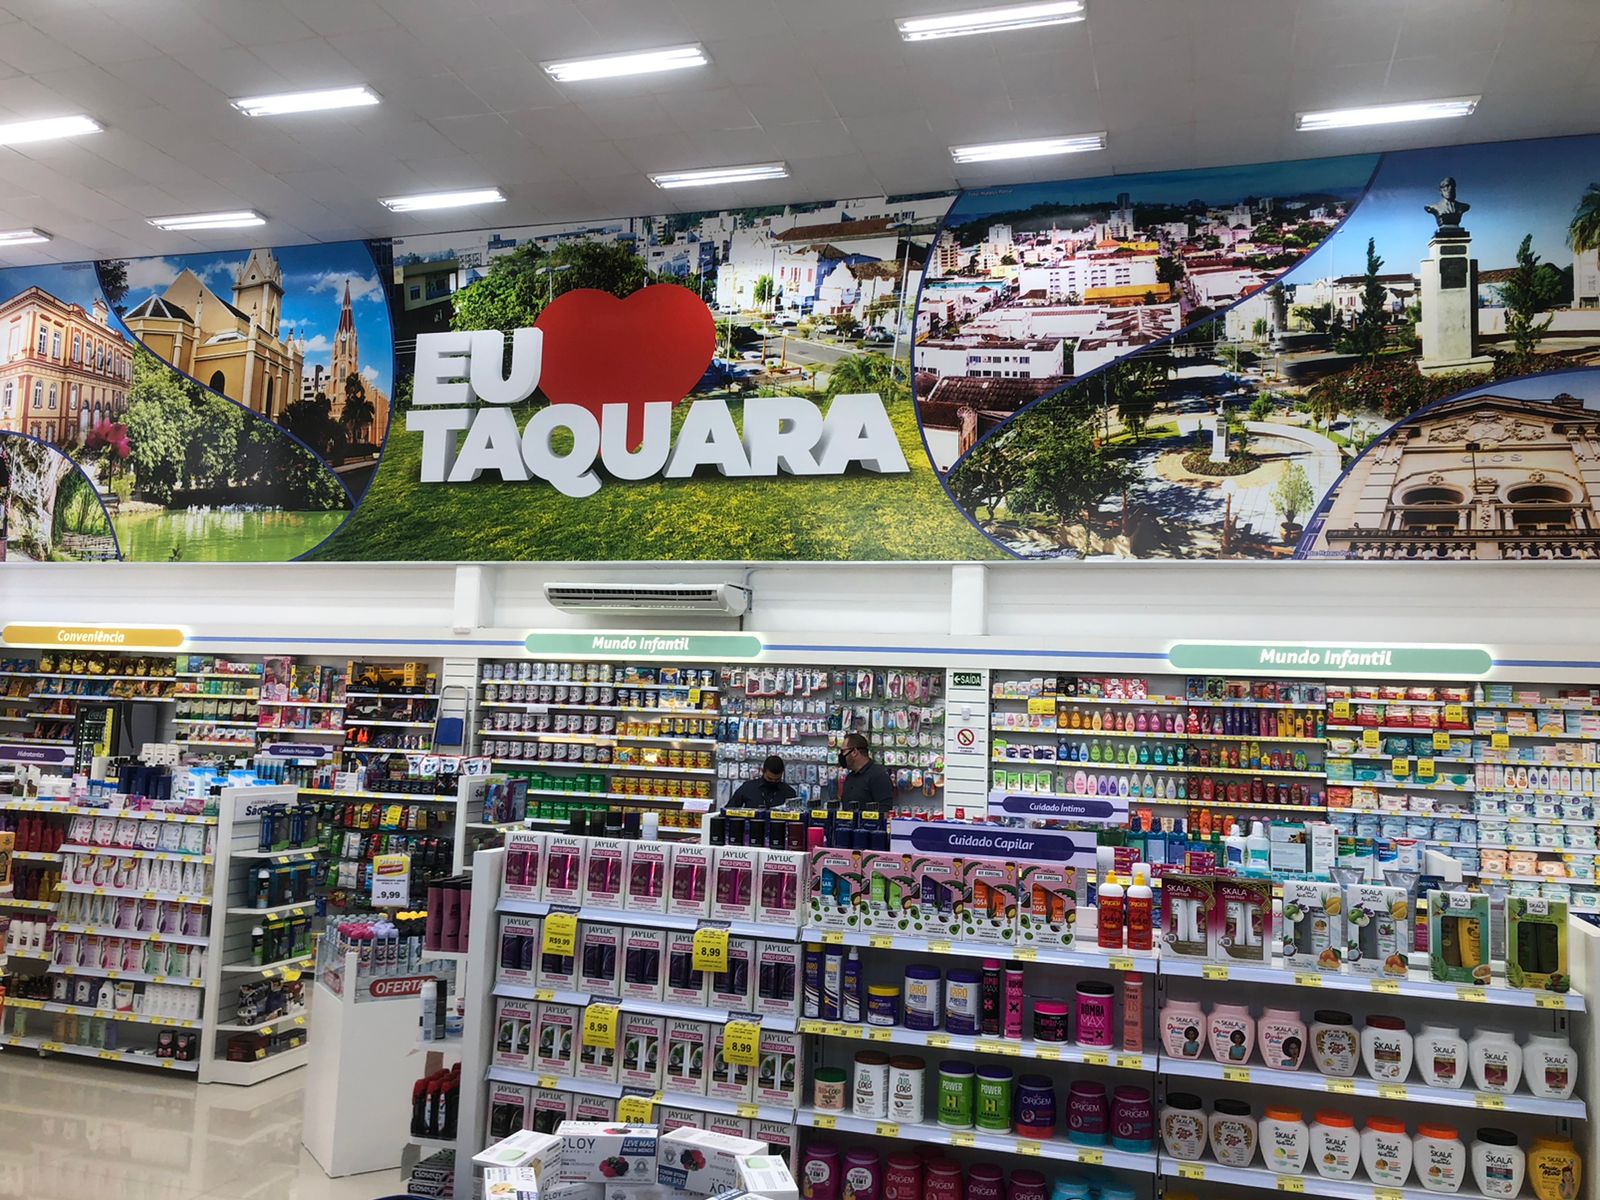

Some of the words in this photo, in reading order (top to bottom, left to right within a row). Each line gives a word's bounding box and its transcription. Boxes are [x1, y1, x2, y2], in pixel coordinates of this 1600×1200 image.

[412, 327, 543, 407] EU
[406, 393, 910, 498] TAQUARA
[57, 629, 125, 644] Conveniência
[592, 636, 637, 651] Mundo
[640, 637, 689, 653] Infantil
[1259, 648, 1320, 666] Mundo
[1324, 649, 1393, 669] Infantil
[960, 674, 980, 684] SAÍDA
[1029, 802, 1061, 813] Cuidado
[1063, 801, 1085, 814] Íntimo
[948, 833, 992, 849] Cuidado
[994, 837, 1034, 852] Capilar
[1167, 884, 1192, 893] SKALA
[1222, 887, 1248, 896] SKALA
[381, 891, 400, 899] 9,99
[1452, 896, 1468, 904] SKALA
[701, 947, 721, 957] 8,99
[376, 978, 434, 994] OFERTA
[1081, 1004, 1104, 1016] BOMBA
[589, 1022, 608, 1032] 8,99
[1081, 1016, 1104, 1028] MAX
[732, 1042, 752, 1053] 8,99
[1374, 1041, 1400, 1050] SKALA
[1433, 1046, 1456, 1054] SKALA
[1484, 1053, 1508, 1062] SKALA
[942, 1080, 964, 1092] POWER
[981, 1084, 1002, 1096] POWER
[1022, 1096, 1051, 1105] ORIGEM
[1071, 1101, 1100, 1112] ORIGEM
[1119, 1108, 1150, 1118] ORIGEM
[625, 1115, 645, 1123] 899
[1275, 1132, 1296, 1140] SKALA
[1325, 1138, 1346, 1146] SKALA
[1377, 1144, 1399, 1152] SKALA
[1430, 1150, 1452, 1159] SKALA
[1485, 1155, 1512, 1164] SKALA
[888, 1173, 915, 1184] ORIGEM
[927, 1180, 955, 1190] ORIGEM
[968, 1185, 998, 1196] ORIGEM
